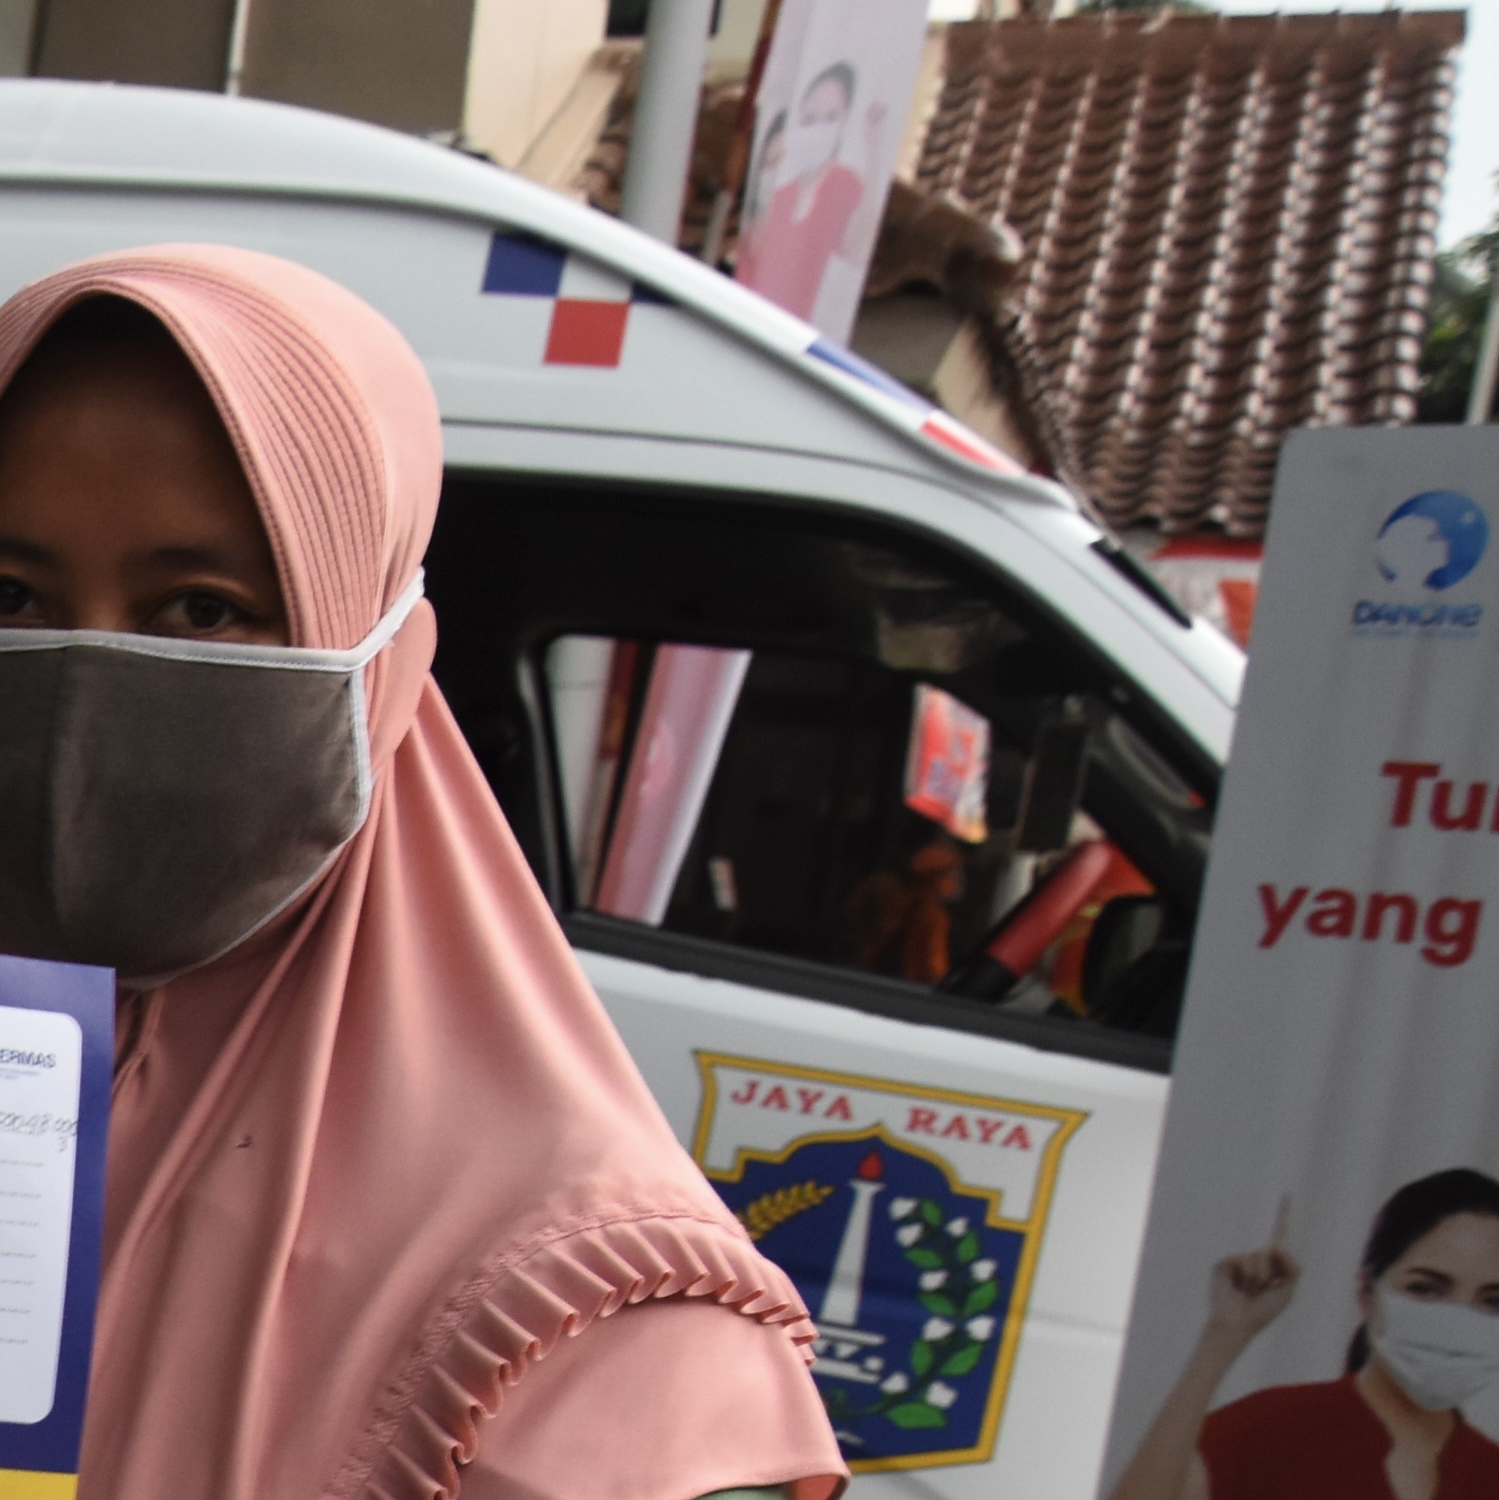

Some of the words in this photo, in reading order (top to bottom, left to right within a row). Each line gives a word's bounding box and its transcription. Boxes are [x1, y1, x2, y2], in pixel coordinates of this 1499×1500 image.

[1381, 761, 1499, 833] Tu
[1257, 883, 1482, 968] yang
[731, 1078, 855, 1122] JAYA
[907, 1106, 1034, 1152] RAYA
